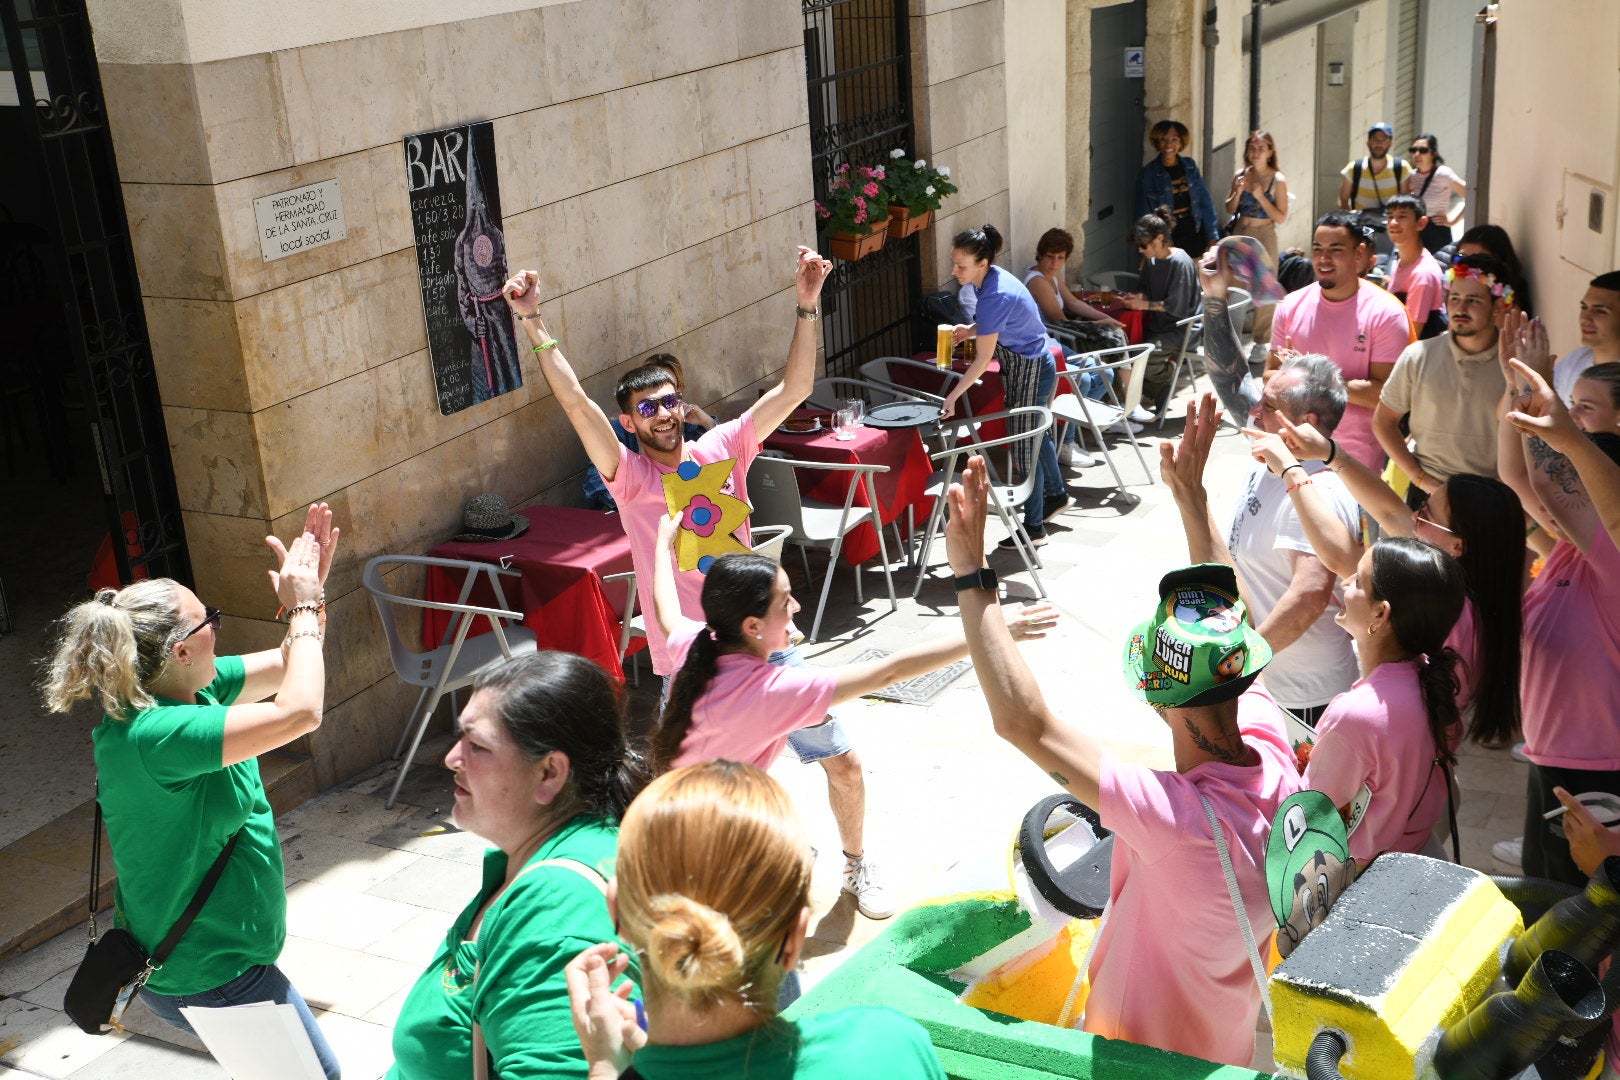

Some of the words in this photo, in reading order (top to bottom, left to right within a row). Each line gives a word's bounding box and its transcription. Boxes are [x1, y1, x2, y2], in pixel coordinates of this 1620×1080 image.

[407, 131, 466, 192] BAR
[272, 190, 316, 210] PATRONATO
[317, 188, 323, 198] Y
[274, 200, 325, 222] HERMANDAD
[265, 226, 277, 239] DE
[278, 223, 290, 236] LA
[291, 216, 317, 232] SANTA
[318, 209, 338, 224] CRUZ
[1157, 626, 1193, 656] SUPER
[1155, 637, 1190, 673] LUIGI
[1135, 678, 1172, 691] MARIO
[1163, 665, 1189, 684] RUN
[1288, 818, 1301, 839] L
